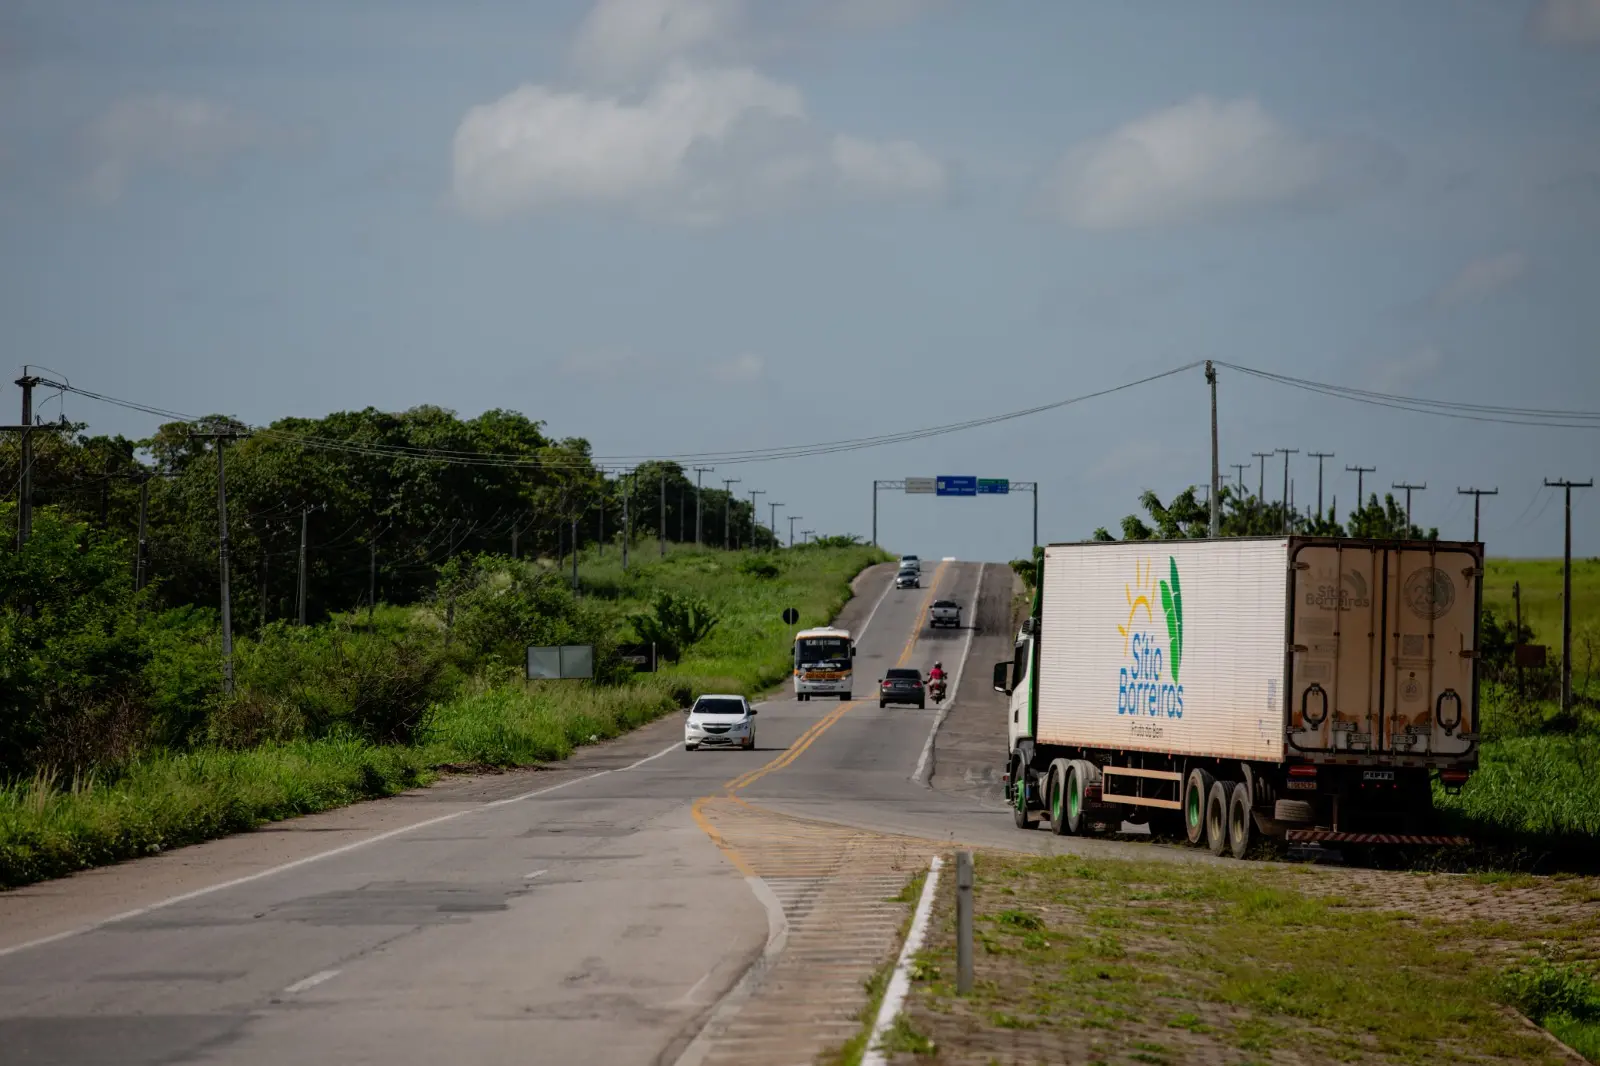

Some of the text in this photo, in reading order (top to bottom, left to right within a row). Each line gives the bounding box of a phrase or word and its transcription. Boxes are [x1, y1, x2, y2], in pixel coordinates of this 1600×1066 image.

[1305, 593, 1370, 607] Barreiros
[1131, 631, 1162, 681] Sítio
[1118, 668, 1184, 719] Barreiros
